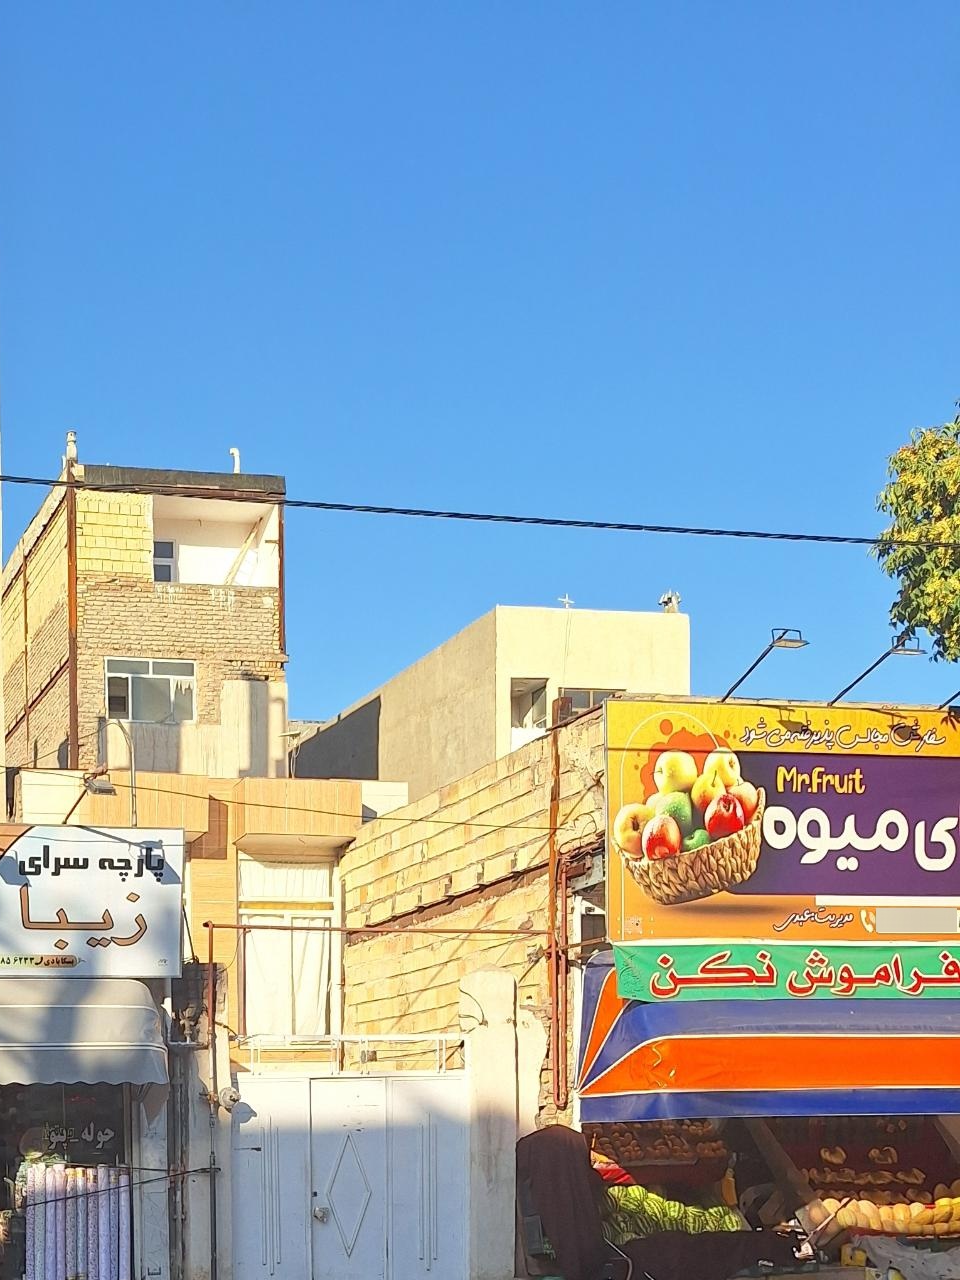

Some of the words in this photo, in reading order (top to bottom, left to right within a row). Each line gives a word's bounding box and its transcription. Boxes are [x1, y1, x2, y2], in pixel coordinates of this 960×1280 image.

[739, 717, 768, 746] شود
[765, 728, 791, 748] می
[835, 725, 889, 750] مجالس
[890, 717, 946, 752] سفارش
[762, 806, 909, 871] میوه
[18, 845, 89, 876] سرای
[98, 847, 164, 882] پارچه
[19, 883, 148, 950] زیبا
[649, 949, 777, 997] نکن
[786, 949, 959, 996] فراموش
[81, 1121, 115, 1149] حوله
